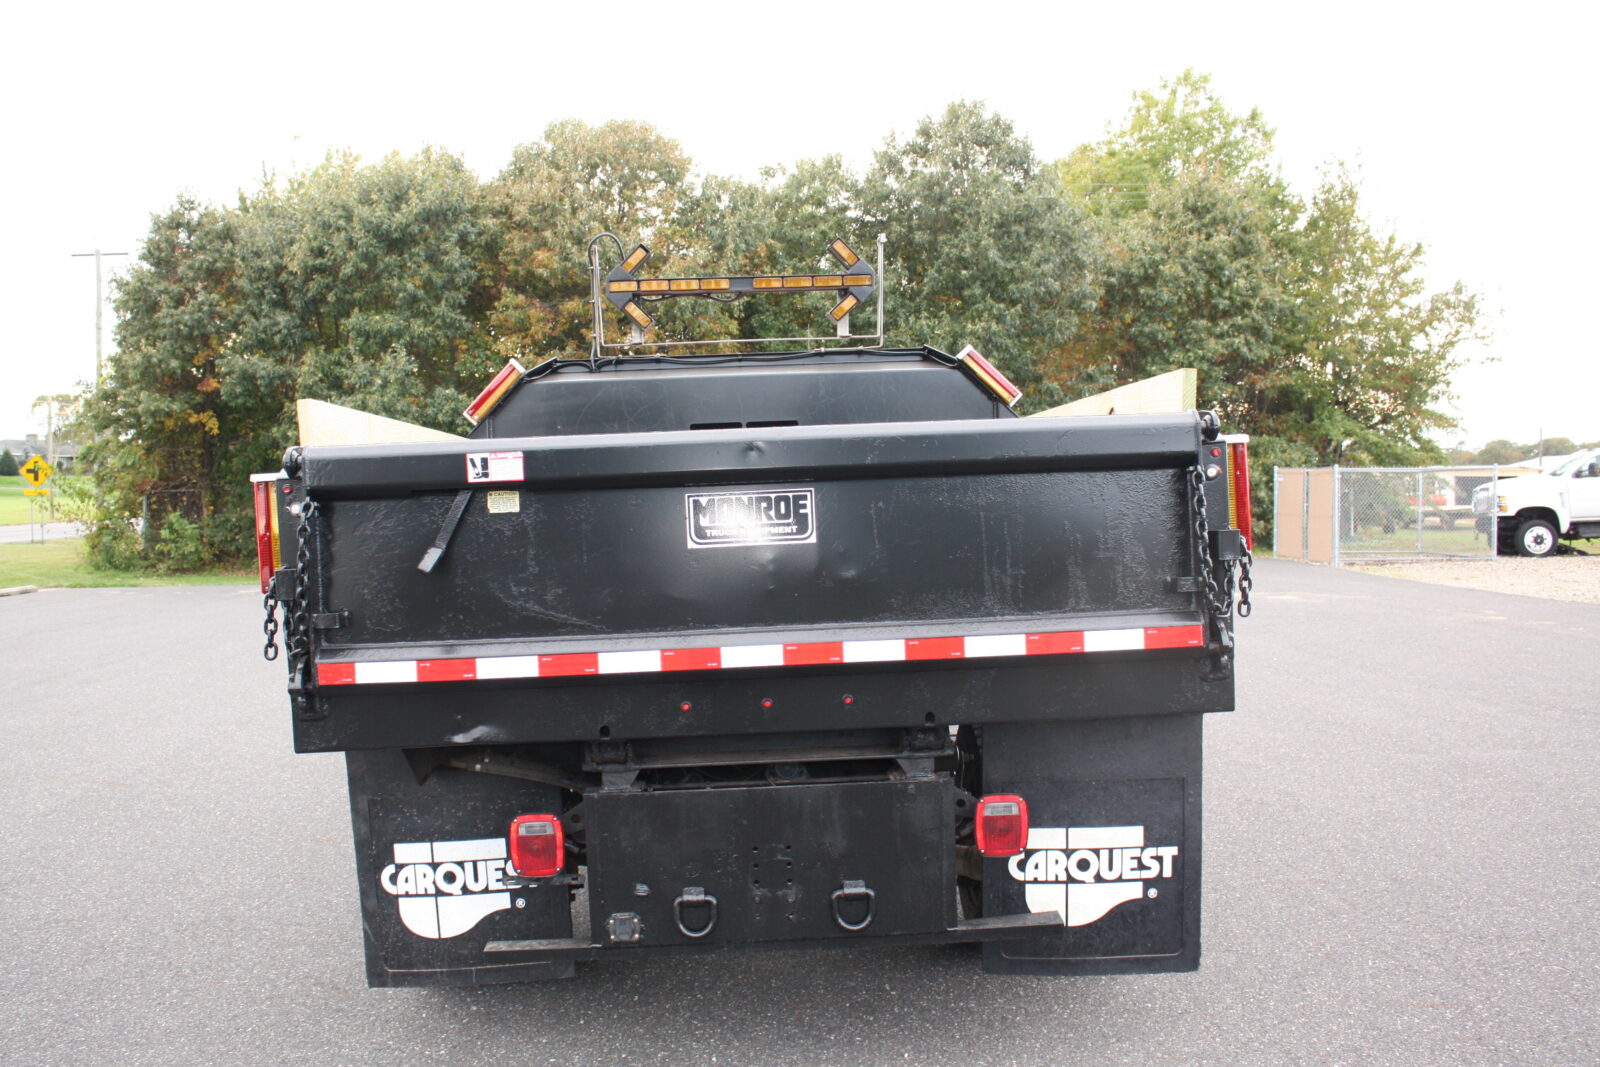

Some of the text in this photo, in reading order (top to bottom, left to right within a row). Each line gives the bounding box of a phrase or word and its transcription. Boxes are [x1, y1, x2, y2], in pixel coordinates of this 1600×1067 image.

[692, 493, 809, 524] MONROE
[746, 525, 798, 536] UIPMENT
[380, 859, 538, 895] CARQUE
[1008, 846, 1178, 883] CARQUEST
